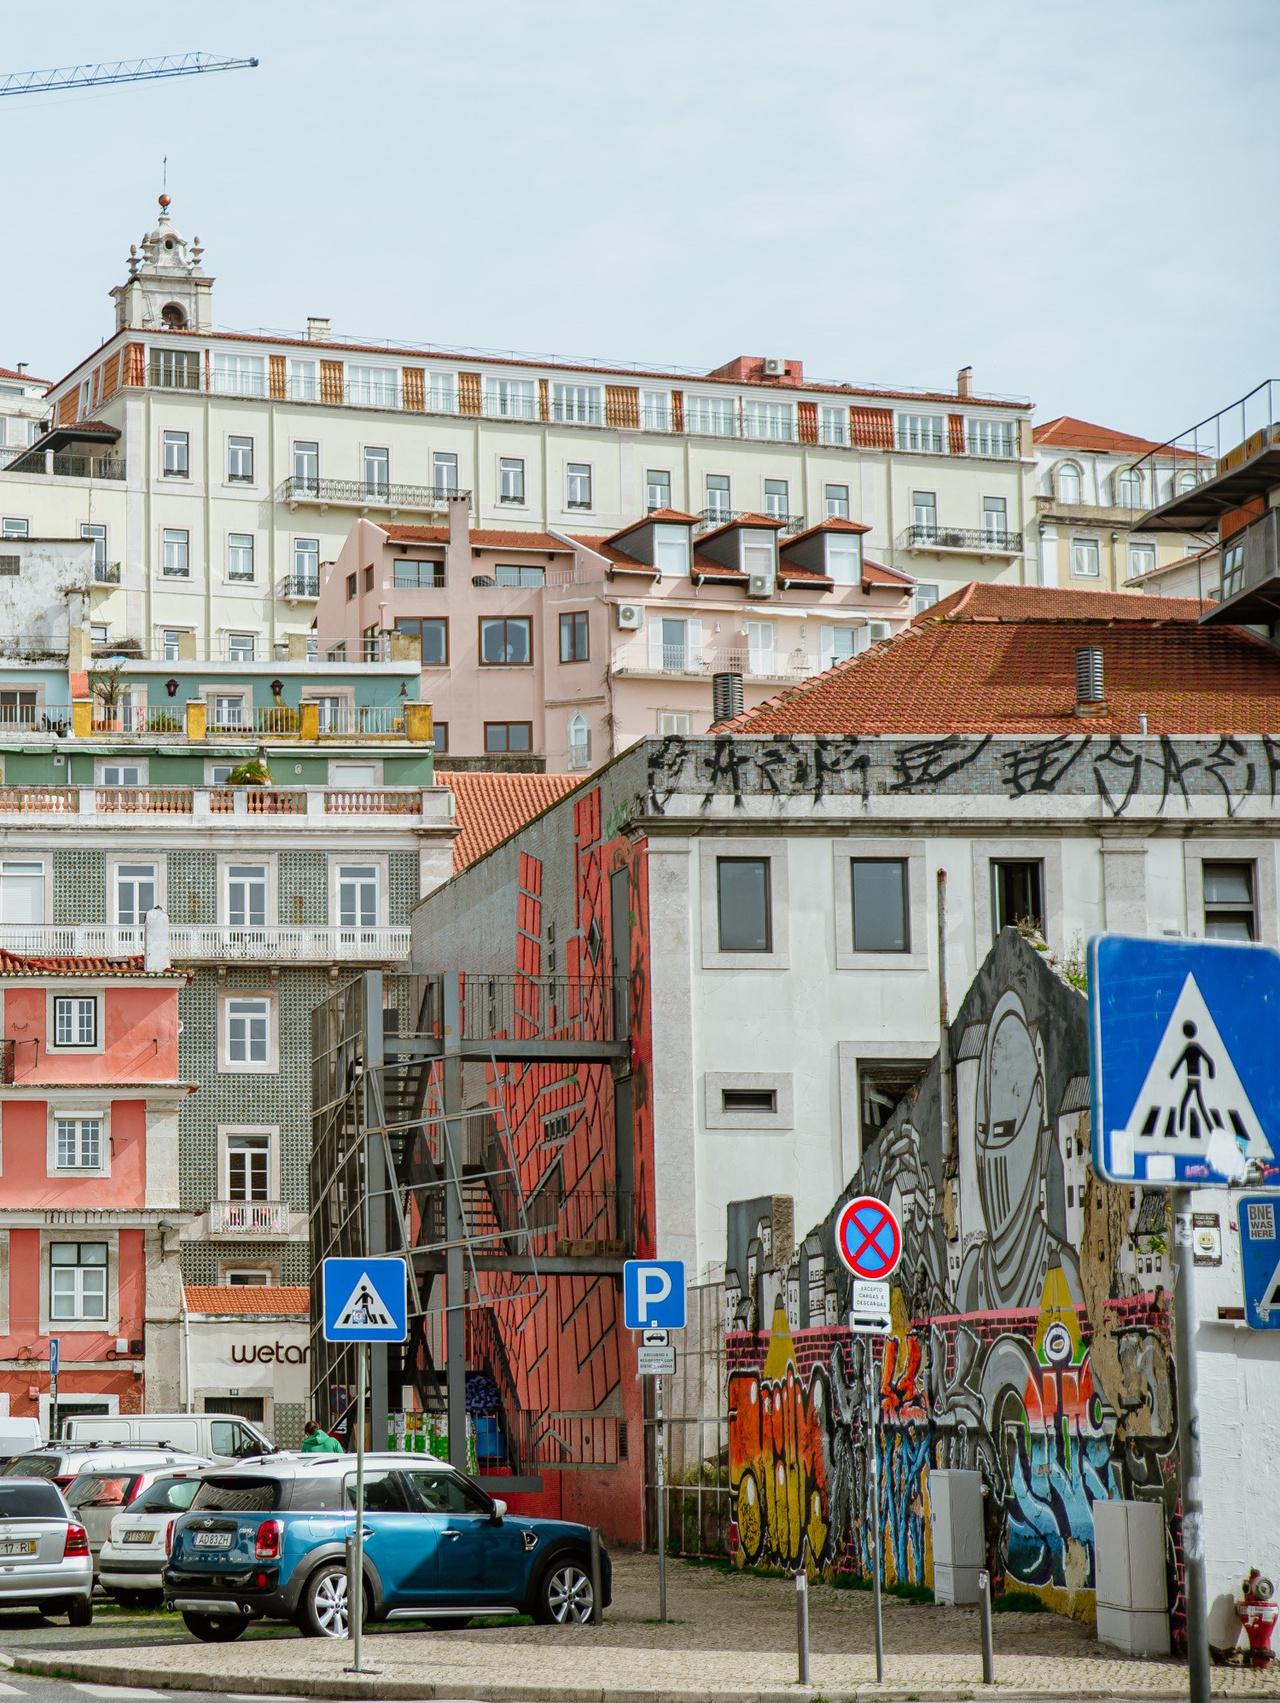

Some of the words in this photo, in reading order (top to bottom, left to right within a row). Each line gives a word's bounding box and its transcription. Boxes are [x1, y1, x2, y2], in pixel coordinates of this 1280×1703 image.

[1249, 1205, 1272, 1221] BNE
[1250, 1220, 1273, 1229] WAS
[1251, 1229, 1274, 1239] HERE
[637, 1267, 672, 1323] P
[859, 1292, 879, 1300] CARGAS
[856, 1299, 887, 1307] DESCARGAS
